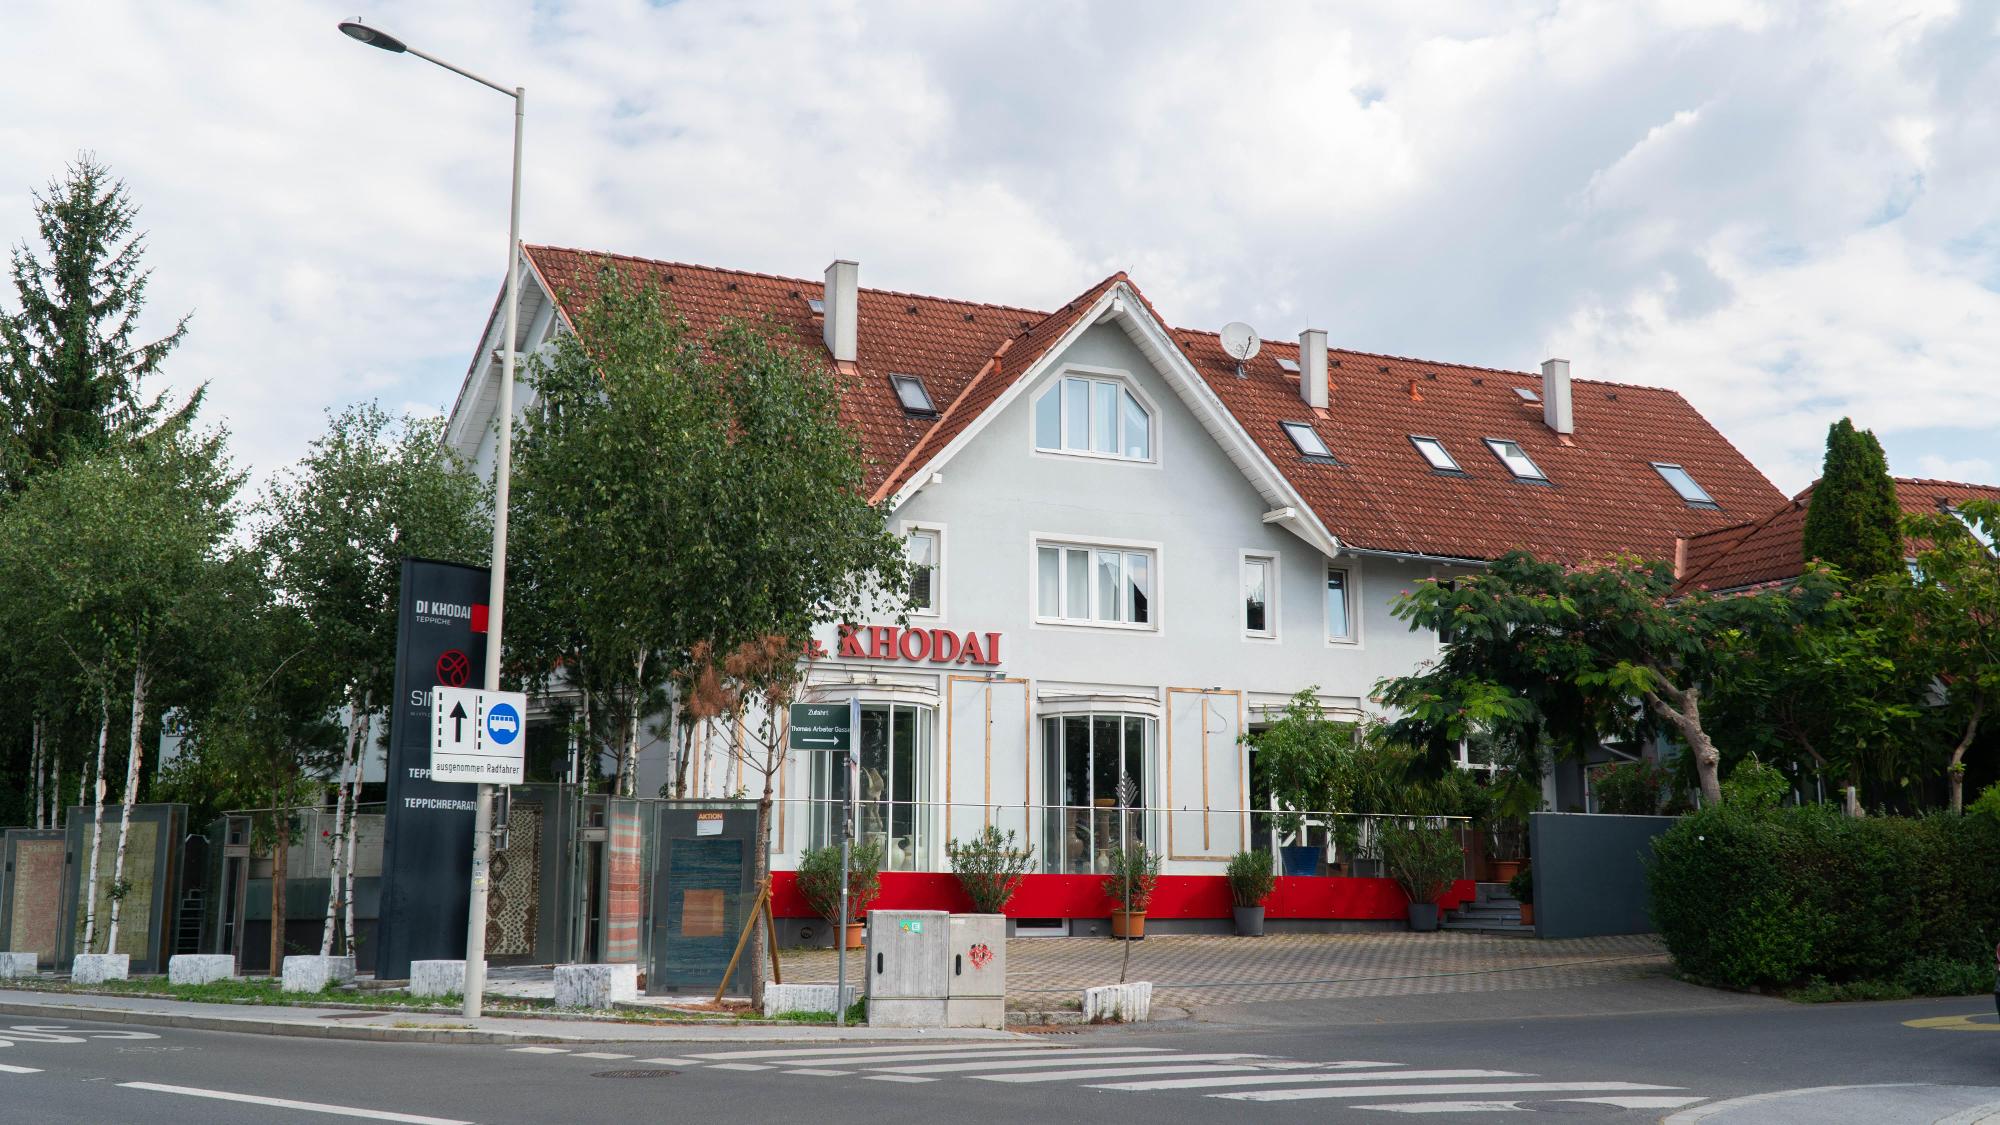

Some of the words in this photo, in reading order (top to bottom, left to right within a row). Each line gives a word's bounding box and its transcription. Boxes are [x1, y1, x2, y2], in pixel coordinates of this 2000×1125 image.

[416, 600, 428, 614] DI
[431, 602, 471, 619] KHODAI
[416, 616, 452, 626] TEPPICHE
[837, 623, 1003, 666] KHODAI
[436, 763, 484, 774] ausgenommen
[486, 763, 520, 774] Radfahrer
